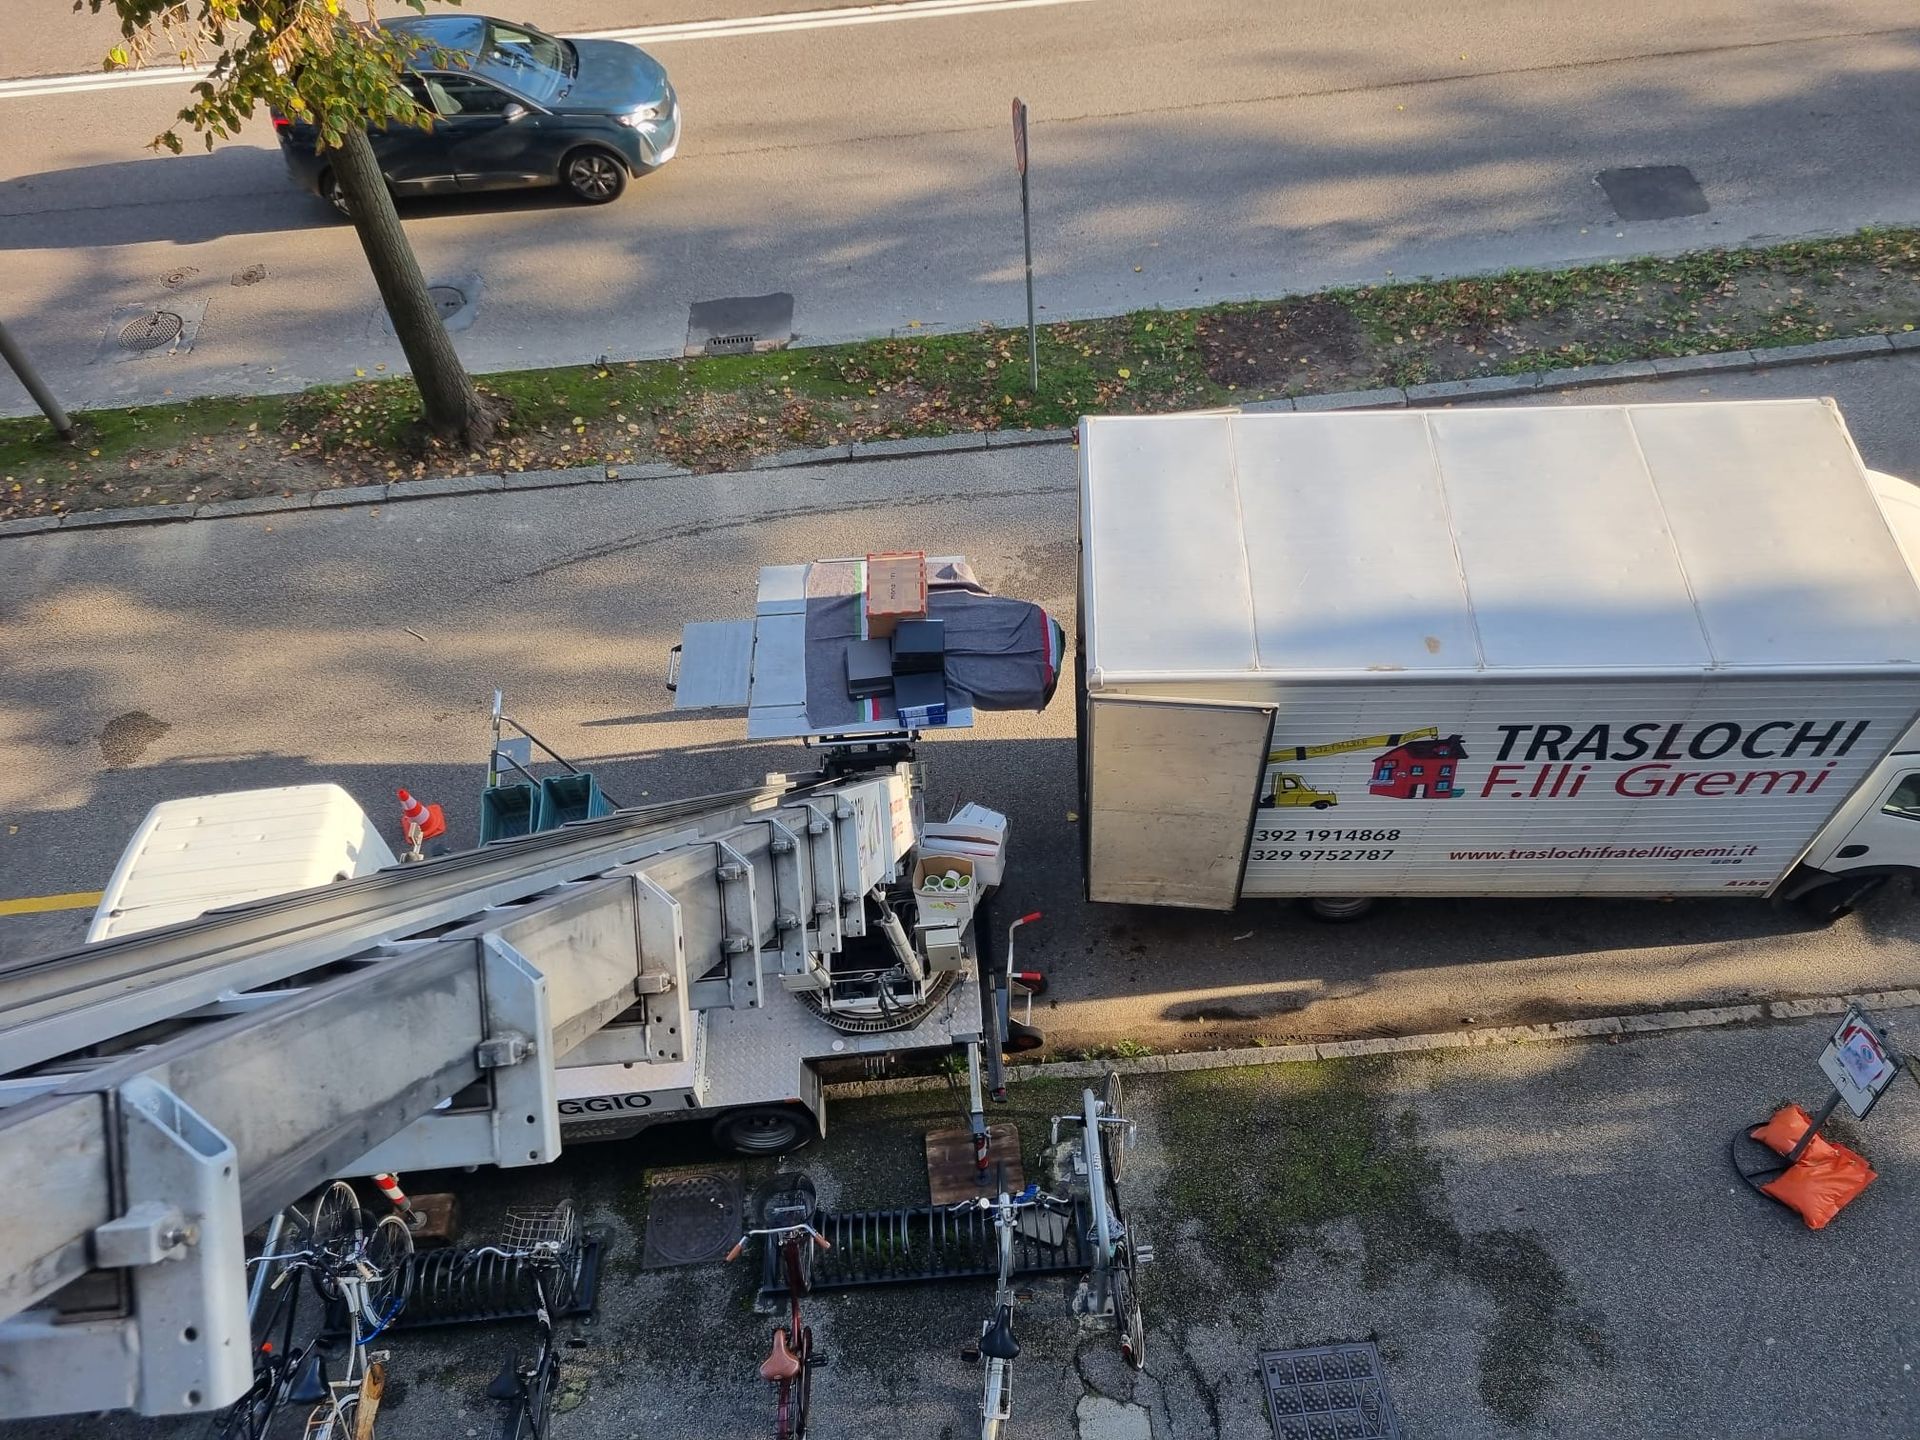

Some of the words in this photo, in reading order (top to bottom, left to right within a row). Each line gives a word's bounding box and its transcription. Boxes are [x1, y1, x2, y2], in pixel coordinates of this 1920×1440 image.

[1496, 720, 1871, 762] TRASLOCHI
[1480, 764, 1592, 798] F.lli
[1614, 761, 1838, 798] Gremi
[1255, 830, 1297, 842] 392
[1305, 829, 1401, 842] 1914868
[1252, 850, 1293, 861] 329
[1299, 849, 1394, 861] 9752787
[1449, 844, 1758, 861] www.traslochifratelligremi.it
